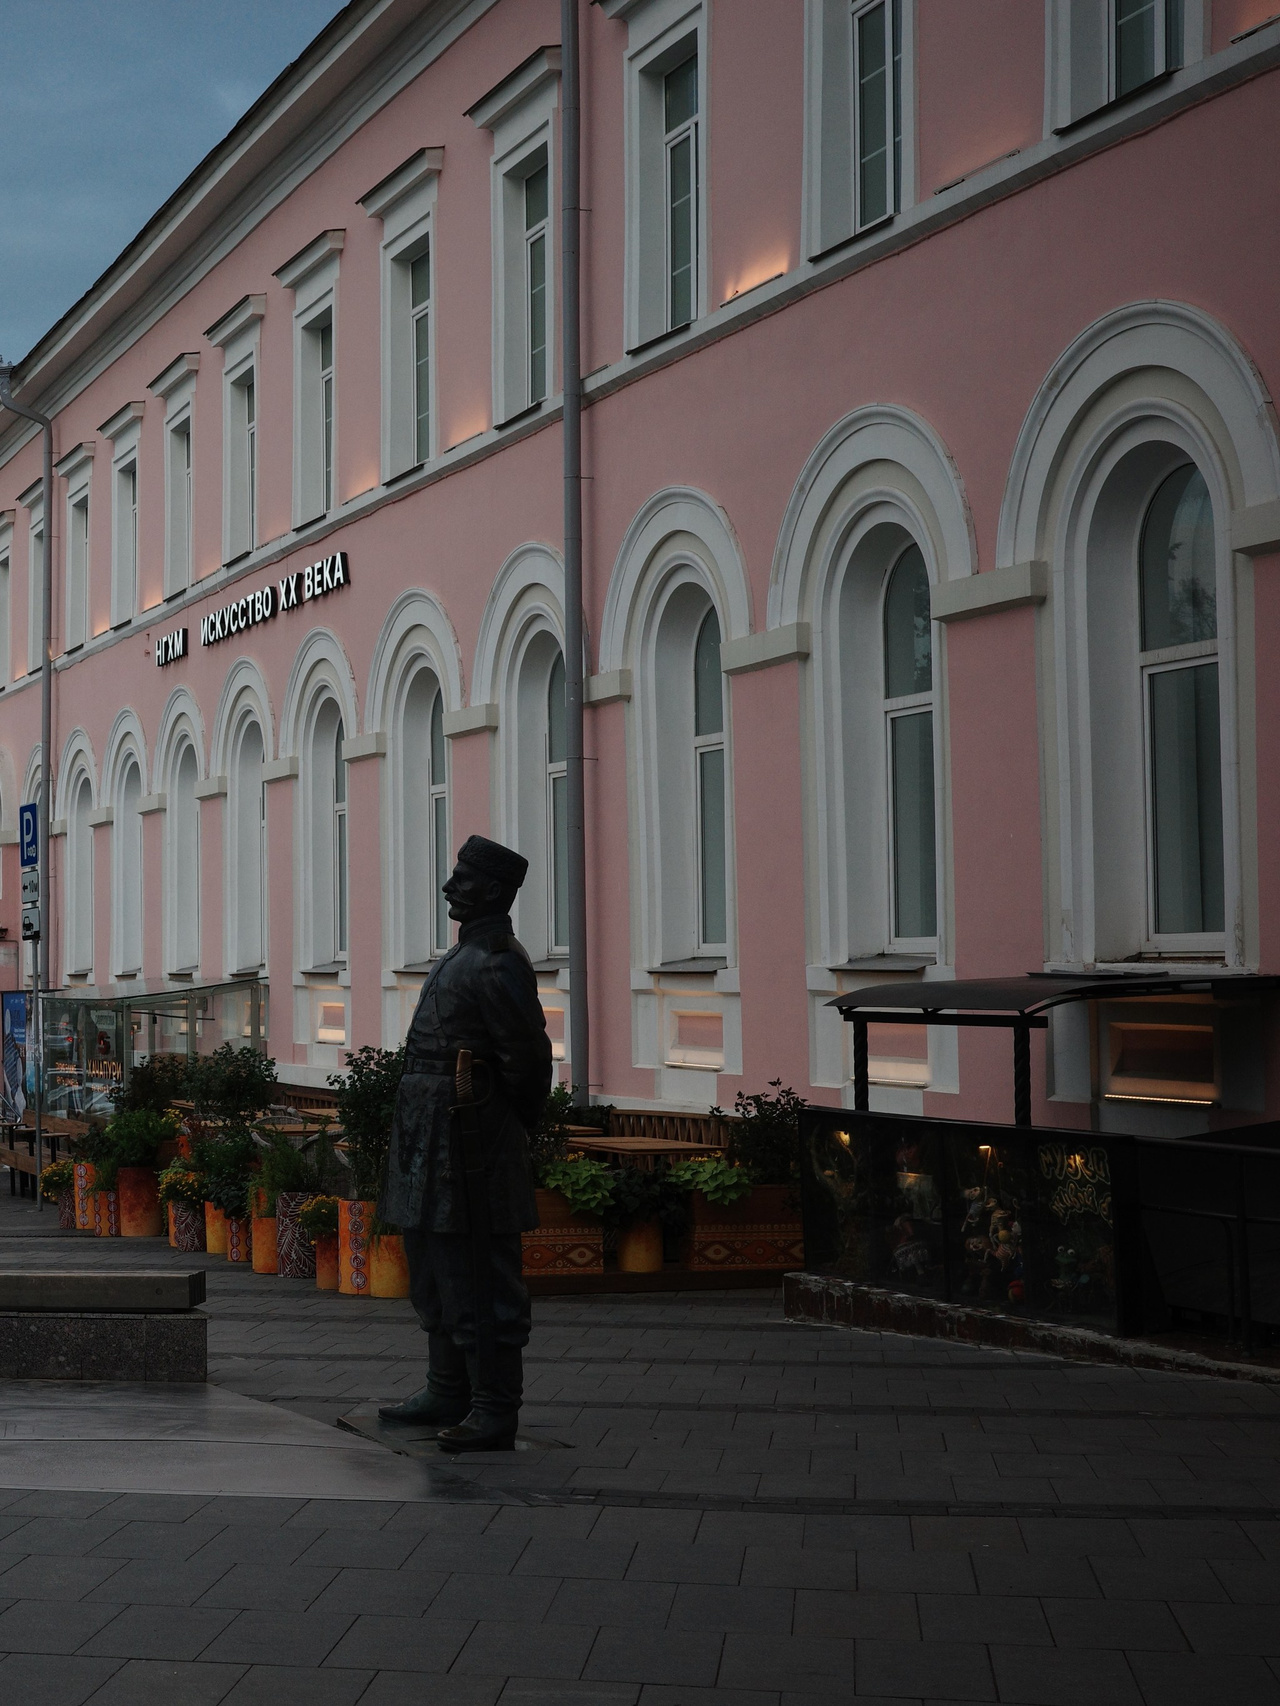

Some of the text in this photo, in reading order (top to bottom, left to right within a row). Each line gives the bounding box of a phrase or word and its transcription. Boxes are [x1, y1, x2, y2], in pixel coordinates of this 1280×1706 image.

[155, 628, 185, 666] НГХМ
[200, 586, 275, 646] ИСКУССТВО
[304, 552, 347, 601] ВЕКА
[23, 811, 33, 860] P
[87, 1059, 122, 1081] ХАЧАПУРИ
